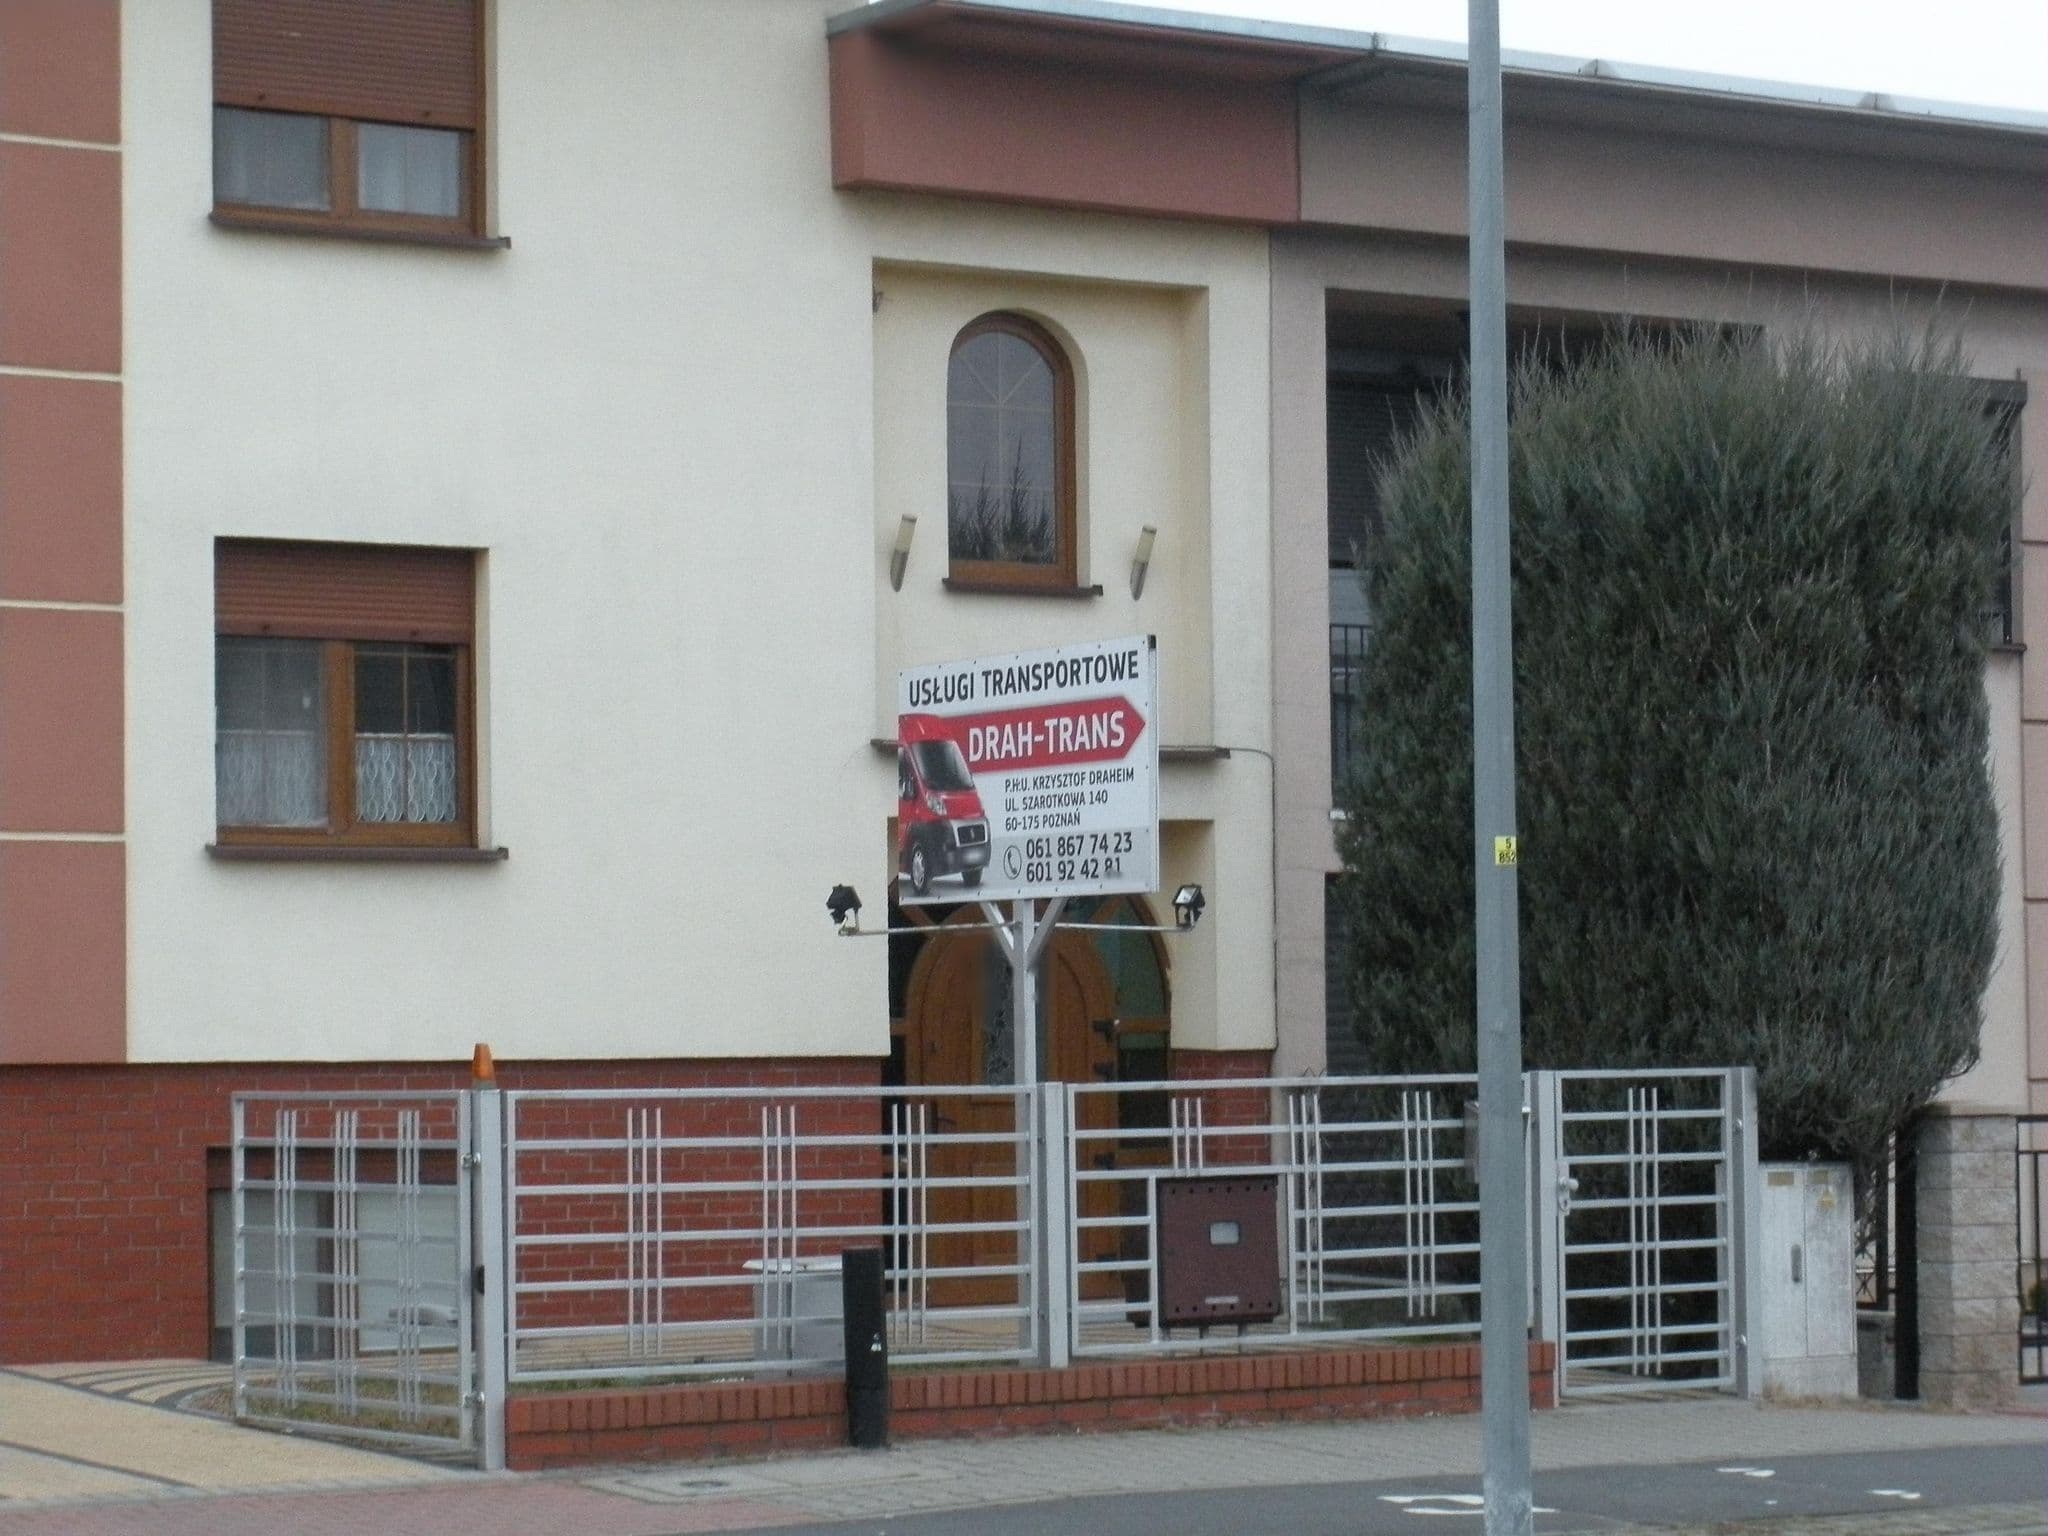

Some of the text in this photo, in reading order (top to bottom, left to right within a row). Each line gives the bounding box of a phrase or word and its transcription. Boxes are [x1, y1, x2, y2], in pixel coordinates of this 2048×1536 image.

[909, 650, 1139, 707] USŁUGI TRANSPORTOWE
[968, 711, 1126, 763] DRAH-TRANS
[1033, 772, 1086, 790] KRZYSZTOF
[1089, 767, 1134, 785] DRAHEIM
[1005, 790, 1108, 812] UL. SZAROTKOWA 140
[1005, 808, 1081, 832] 60-175 POZNAŃ
[1026, 831, 1133, 859] 061 867 74 23
[1026, 861, 1052, 882] 601
[1057, 860, 1075, 881] 92
[1080, 858, 1099, 879] 42
